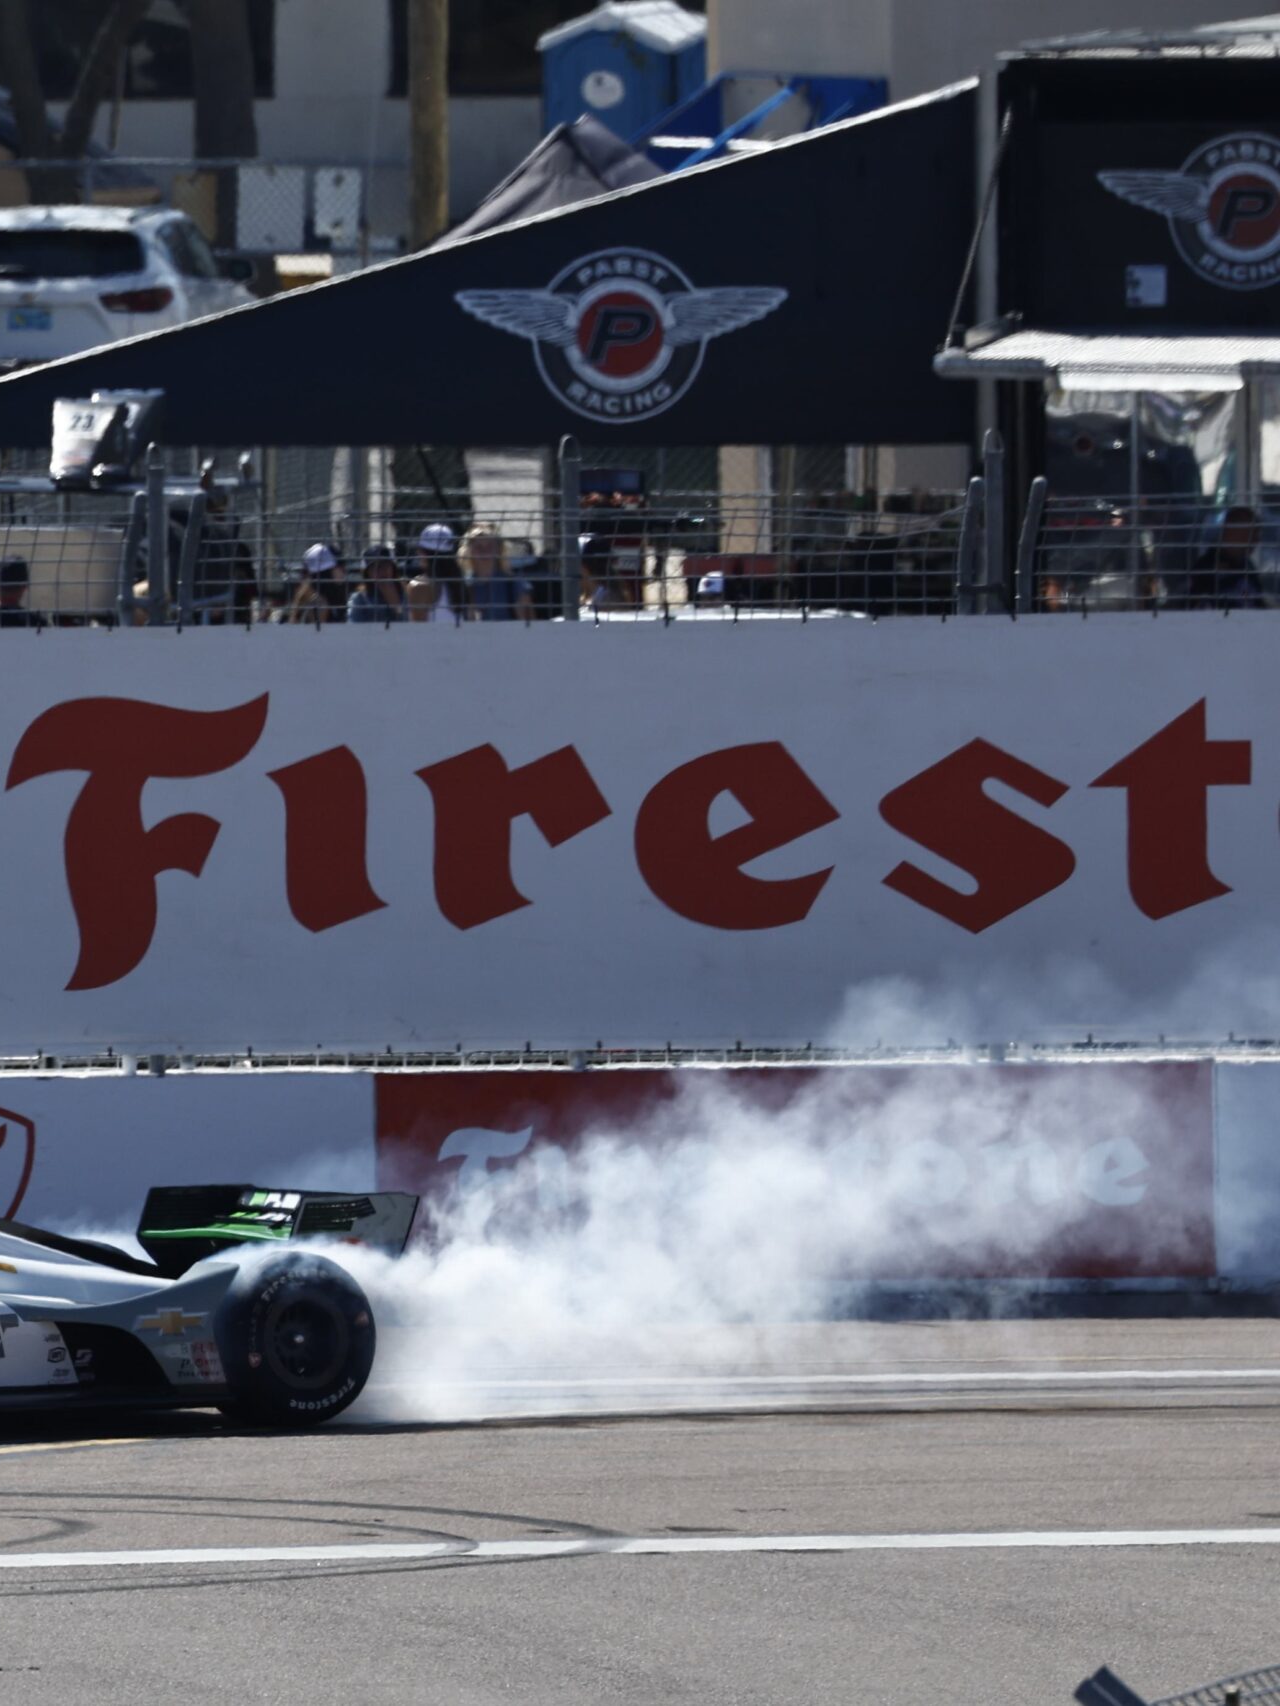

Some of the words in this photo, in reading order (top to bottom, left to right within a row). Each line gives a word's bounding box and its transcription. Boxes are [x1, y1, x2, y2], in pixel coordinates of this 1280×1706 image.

[576, 256, 670, 285] PABST
[1199, 252, 1280, 282] RACIN
[586, 305, 657, 368] P
[564, 381, 674, 415] RACING
[4, 690, 1280, 990] Firest
[259, 1267, 330, 1302] Firestone
[287, 1376, 358, 1411] Firestone
